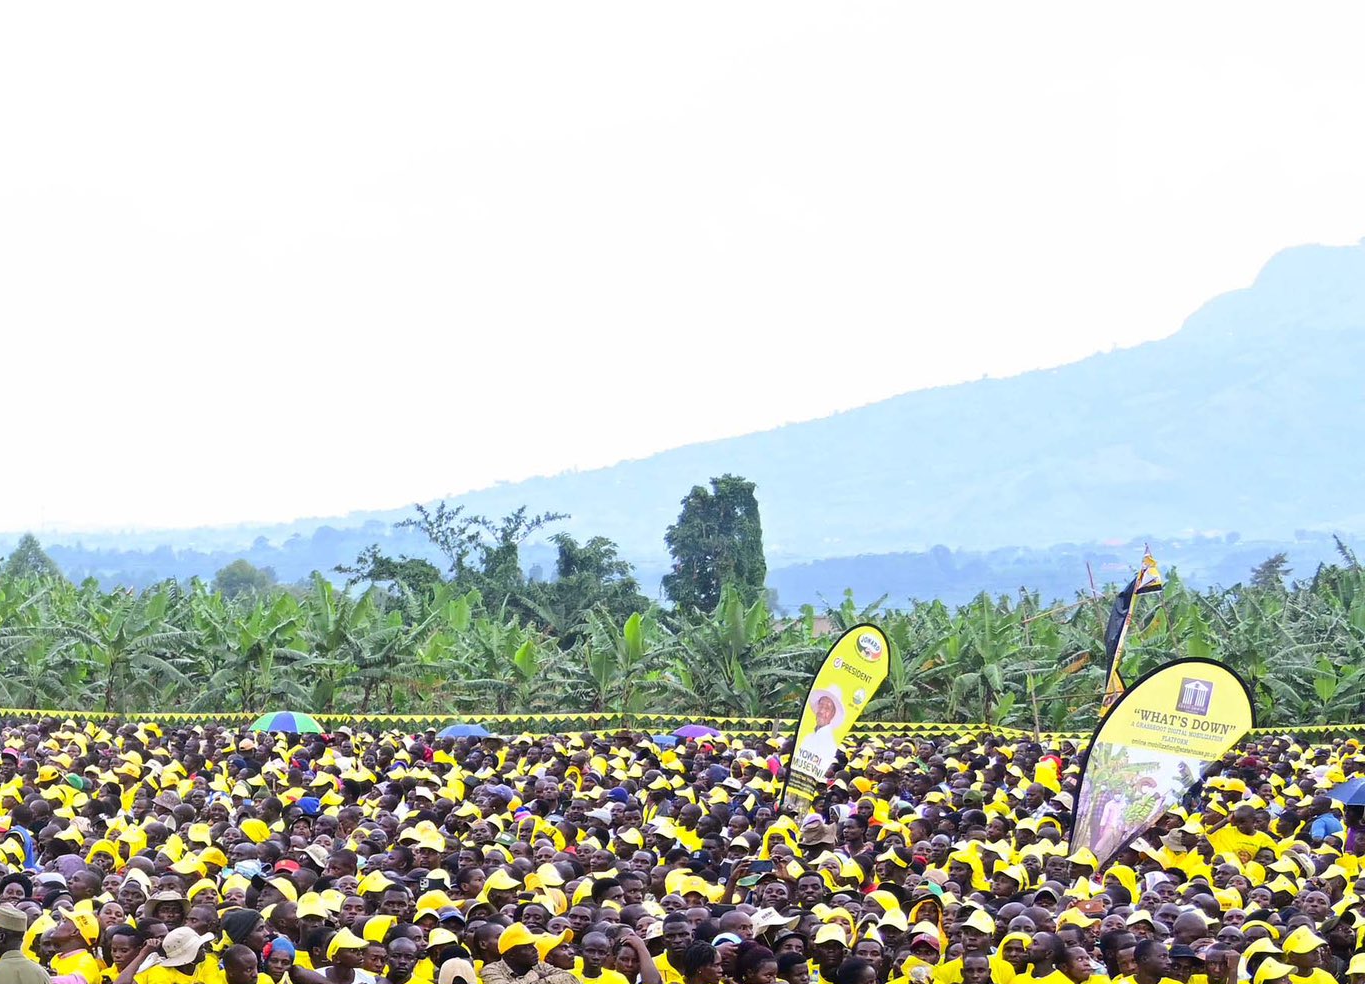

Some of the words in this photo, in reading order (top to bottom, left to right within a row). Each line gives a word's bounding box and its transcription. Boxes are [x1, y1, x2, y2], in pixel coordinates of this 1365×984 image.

[841, 662, 873, 684] PRESIDENT
[1167, 727, 1187, 736] DIGITAL
[1162, 736, 1189, 746] PLATFORM
